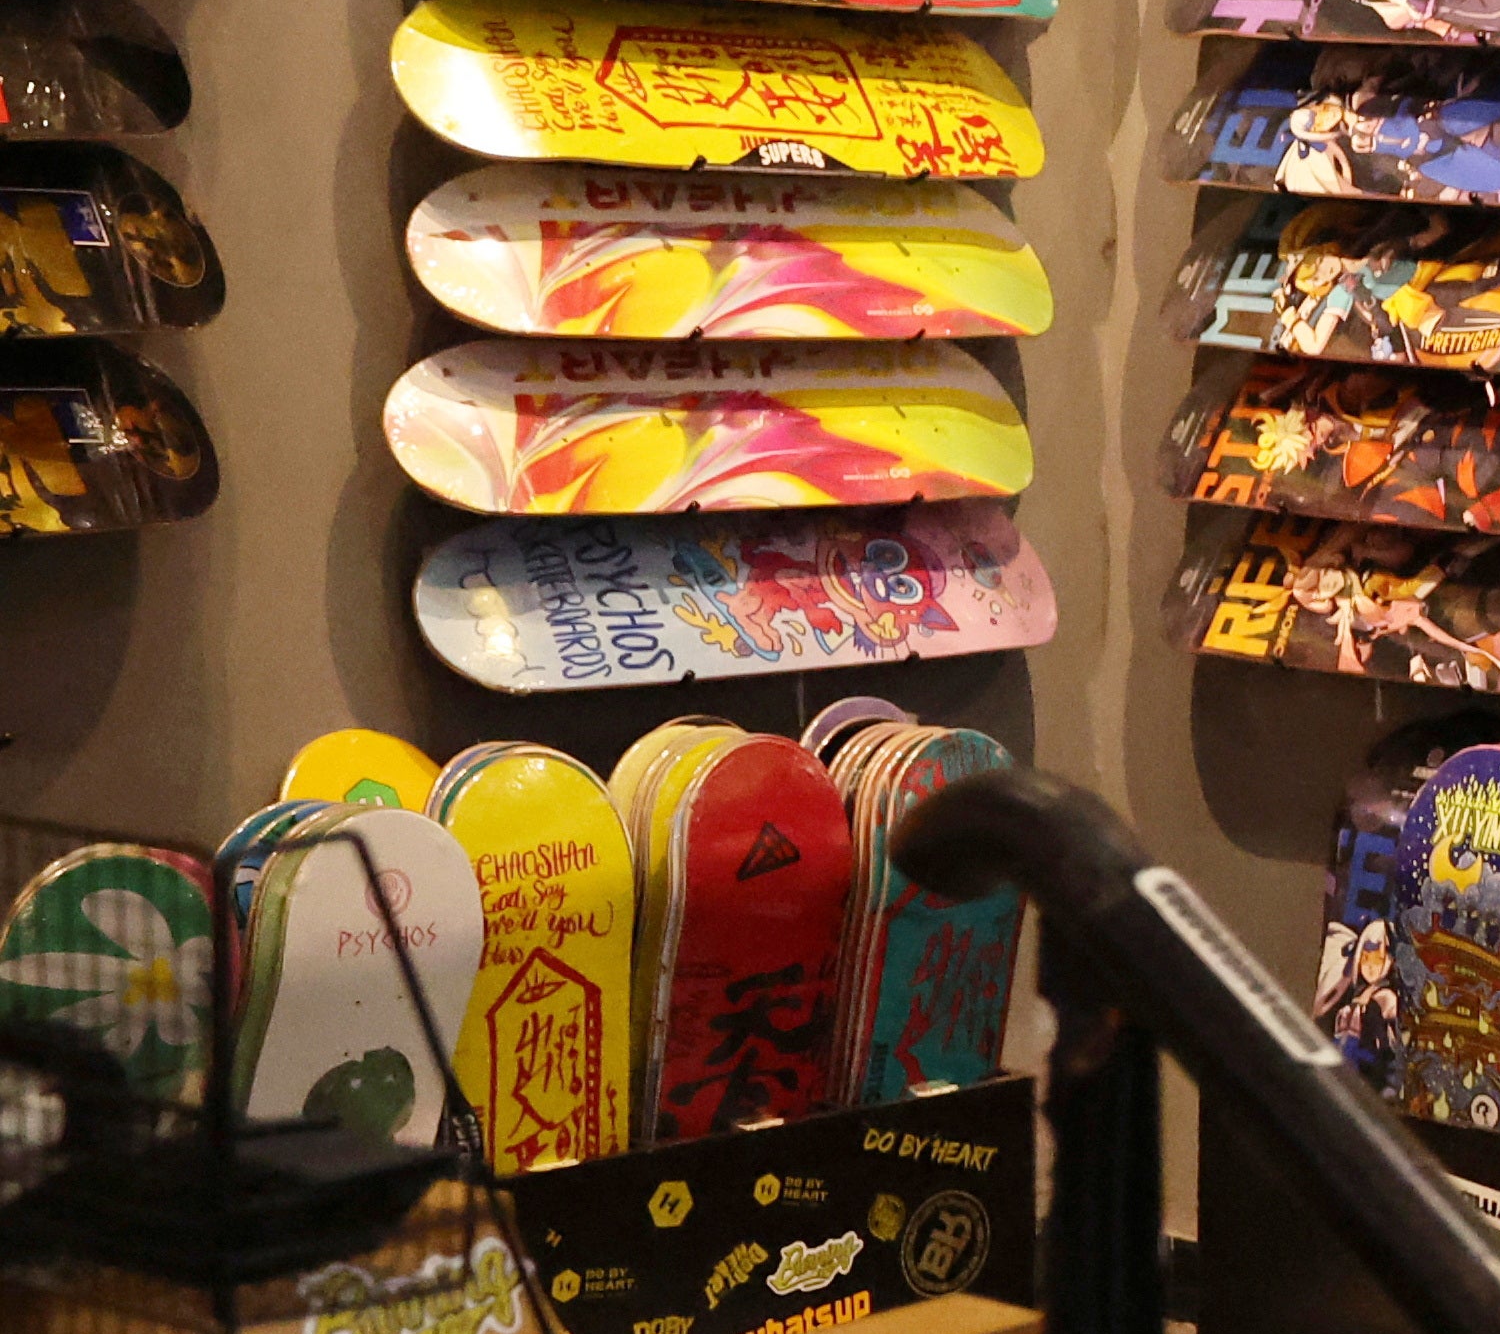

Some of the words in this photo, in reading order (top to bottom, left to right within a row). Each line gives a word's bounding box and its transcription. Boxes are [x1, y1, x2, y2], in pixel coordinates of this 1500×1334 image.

[863, 1128, 896, 1155] DO
[898, 1131, 928, 1159] BY
[930, 1135, 999, 1173] HEART
